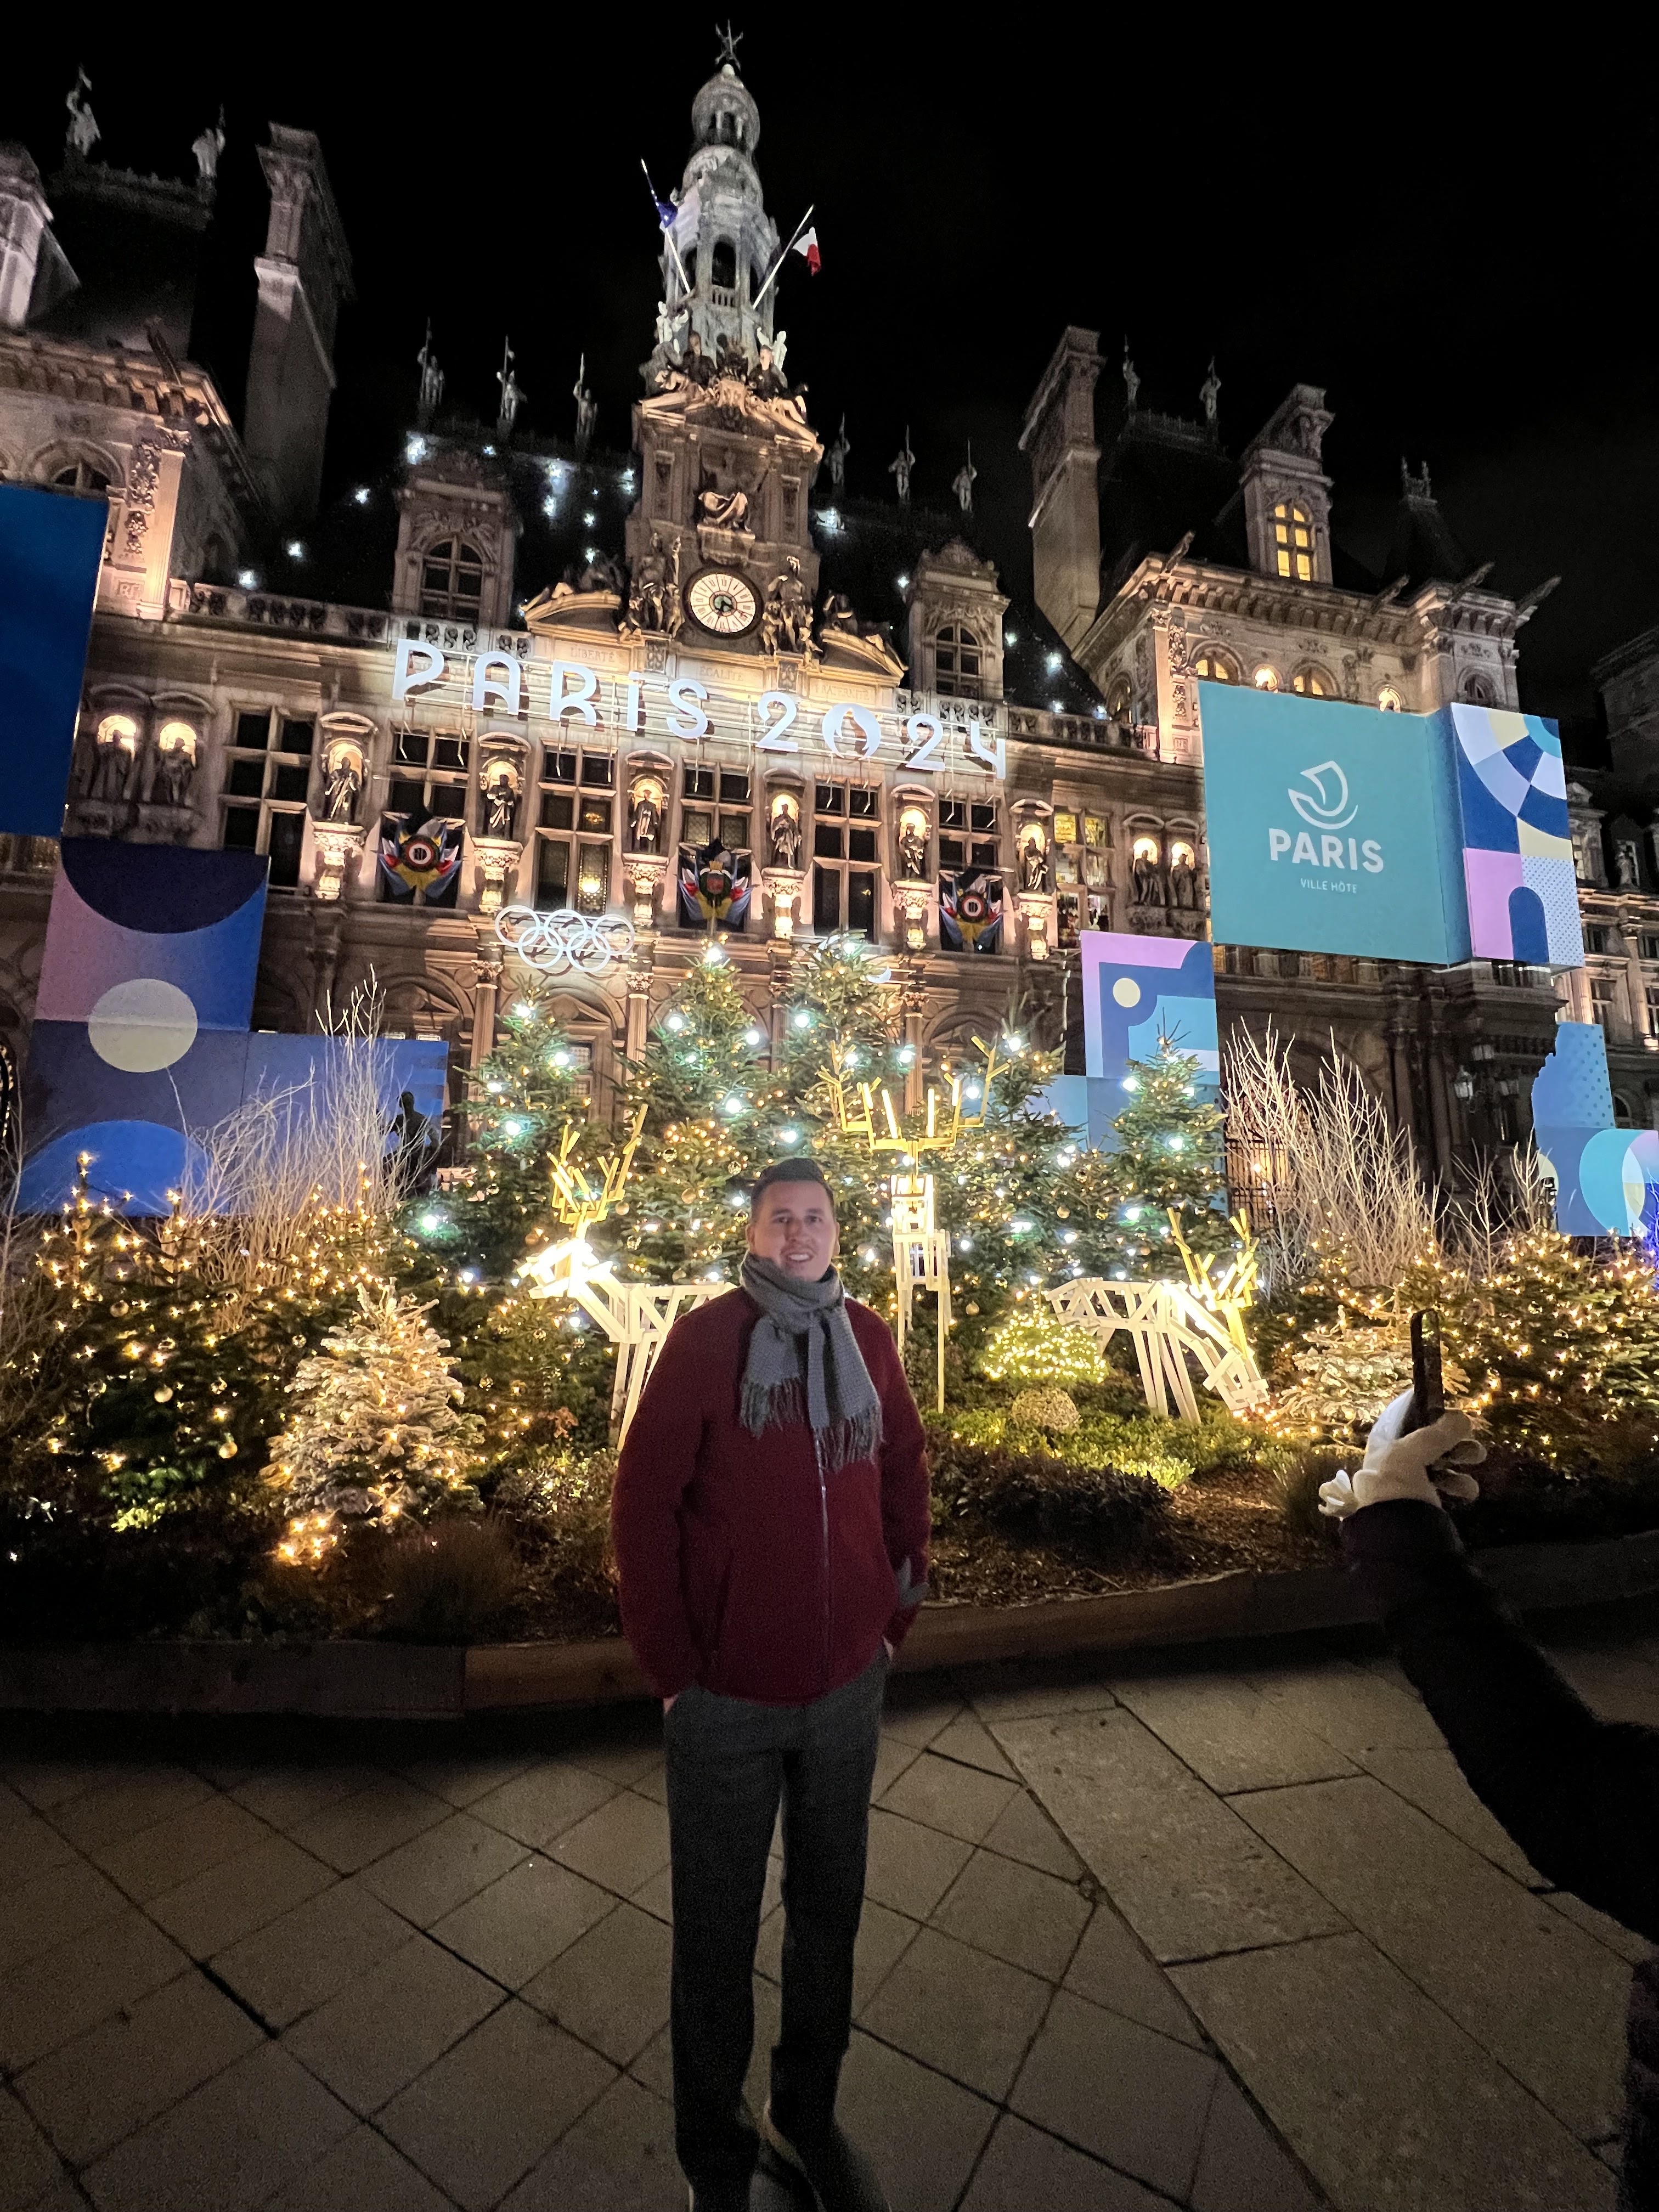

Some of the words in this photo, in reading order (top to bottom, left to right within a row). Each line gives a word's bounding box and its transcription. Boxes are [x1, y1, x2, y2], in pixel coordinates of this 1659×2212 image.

[571, 646, 615, 663] LIBERTÉ
[393, 639, 709, 740] PARIS
[755, 691, 1006, 780] 2024
[1268, 828, 1384, 873] PARIS
[1300, 878, 1328, 890] VILLE
[1331, 881, 1357, 894] HÔTE
